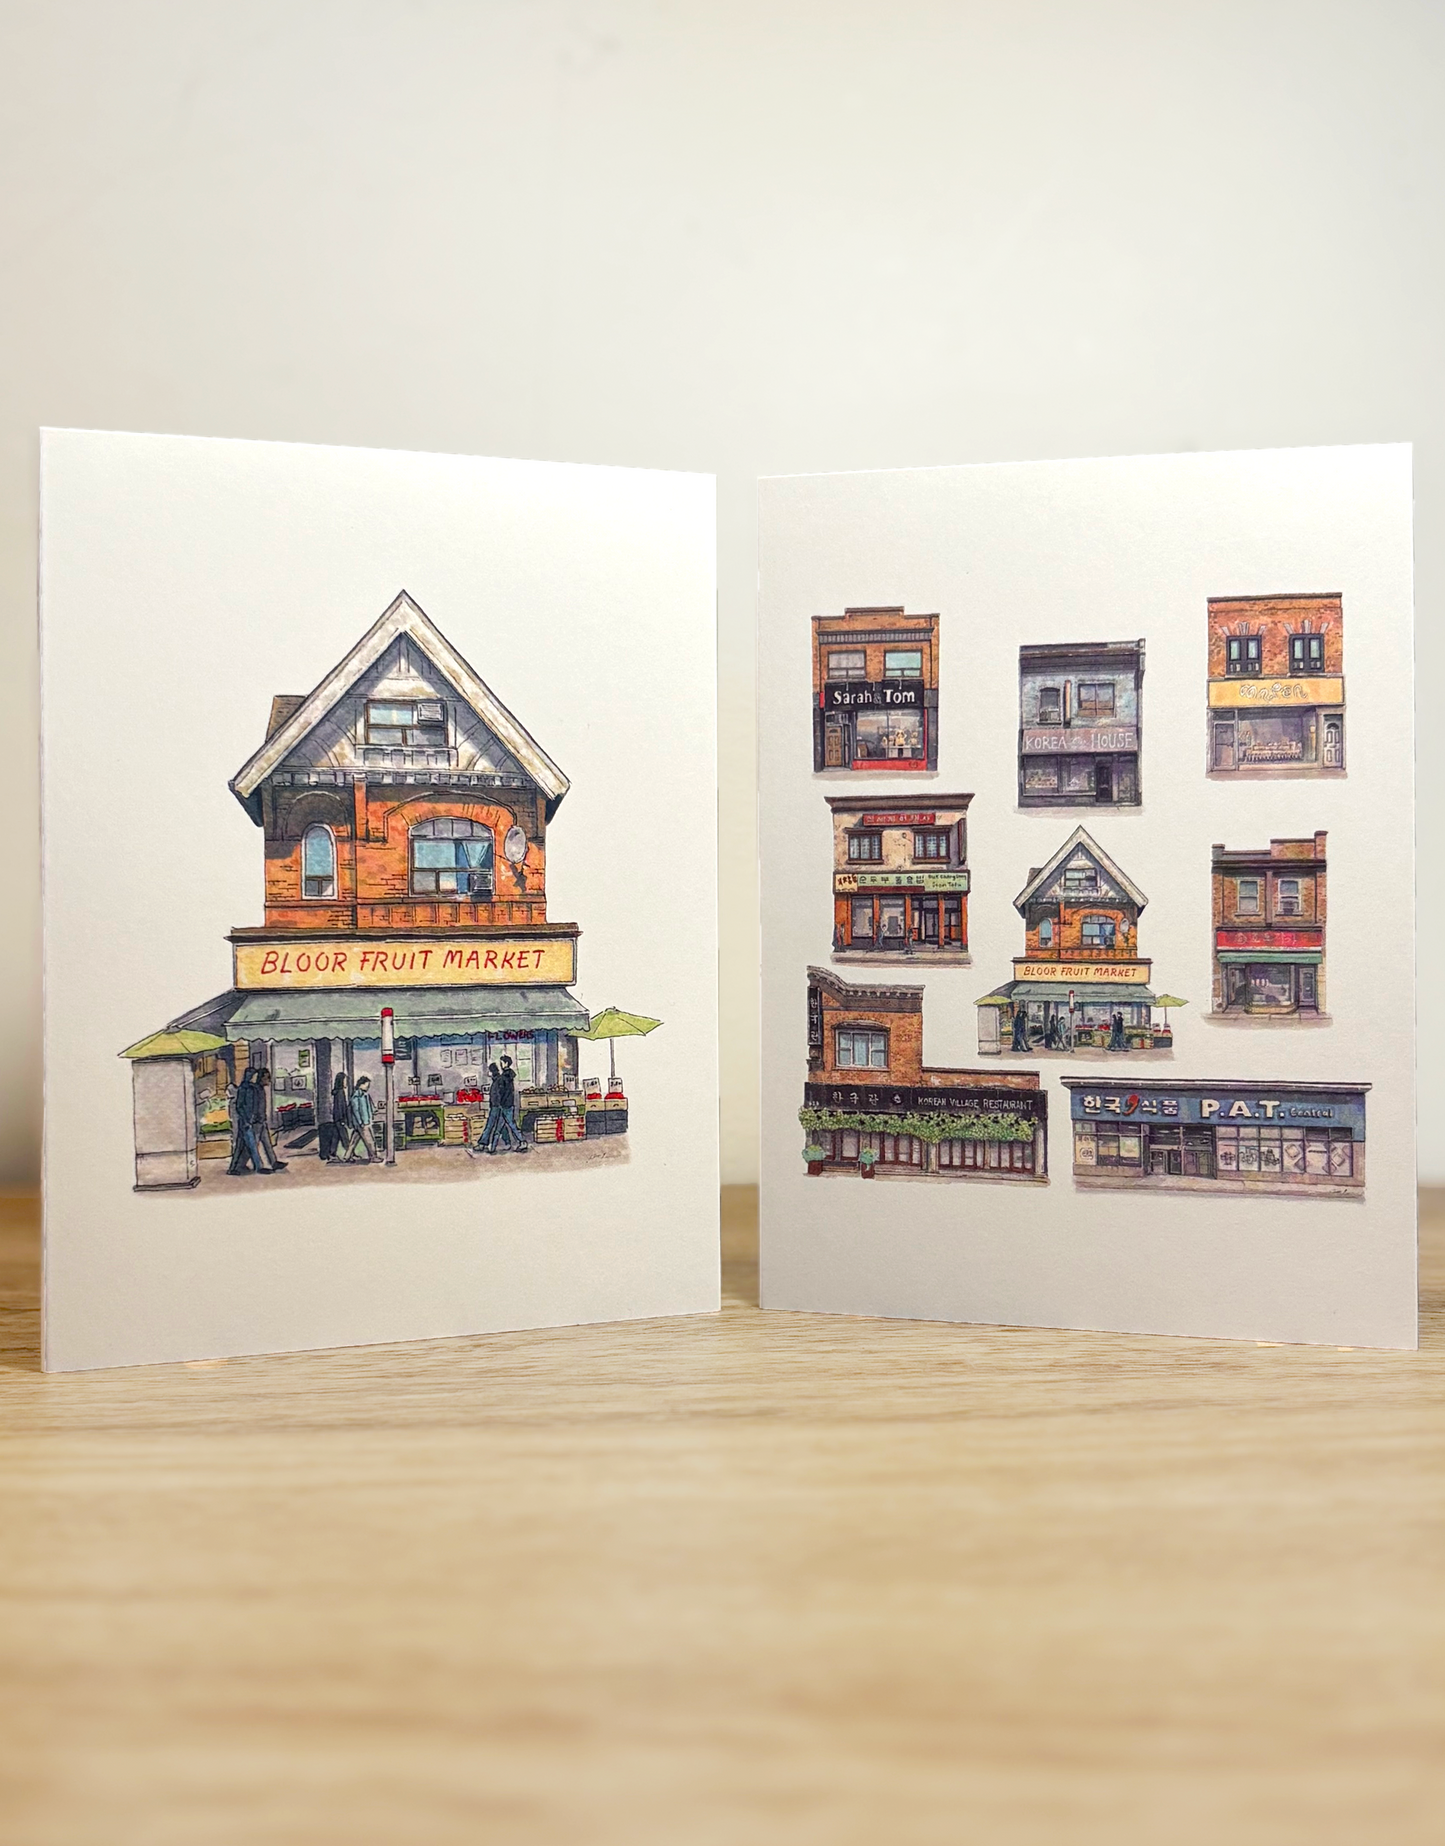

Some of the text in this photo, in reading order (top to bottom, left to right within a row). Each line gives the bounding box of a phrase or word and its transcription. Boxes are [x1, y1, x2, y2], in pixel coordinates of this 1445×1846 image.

[833, 690, 872, 704] Sarah
[883, 689, 915, 703] Tom
[1025, 733, 1134, 750] KOREA HOUSE
[261, 949, 546, 975] BLOOR FRUIT MARKET
[1023, 966, 1137, 977] BLOOR FRUIT MARKET
[487, 1029, 535, 1041] FLOWERS
[917, 1096, 1034, 1111] KOREAN VILLAGE RESTAURANT
[1201, 1099, 1284, 1118] P.A.T.
